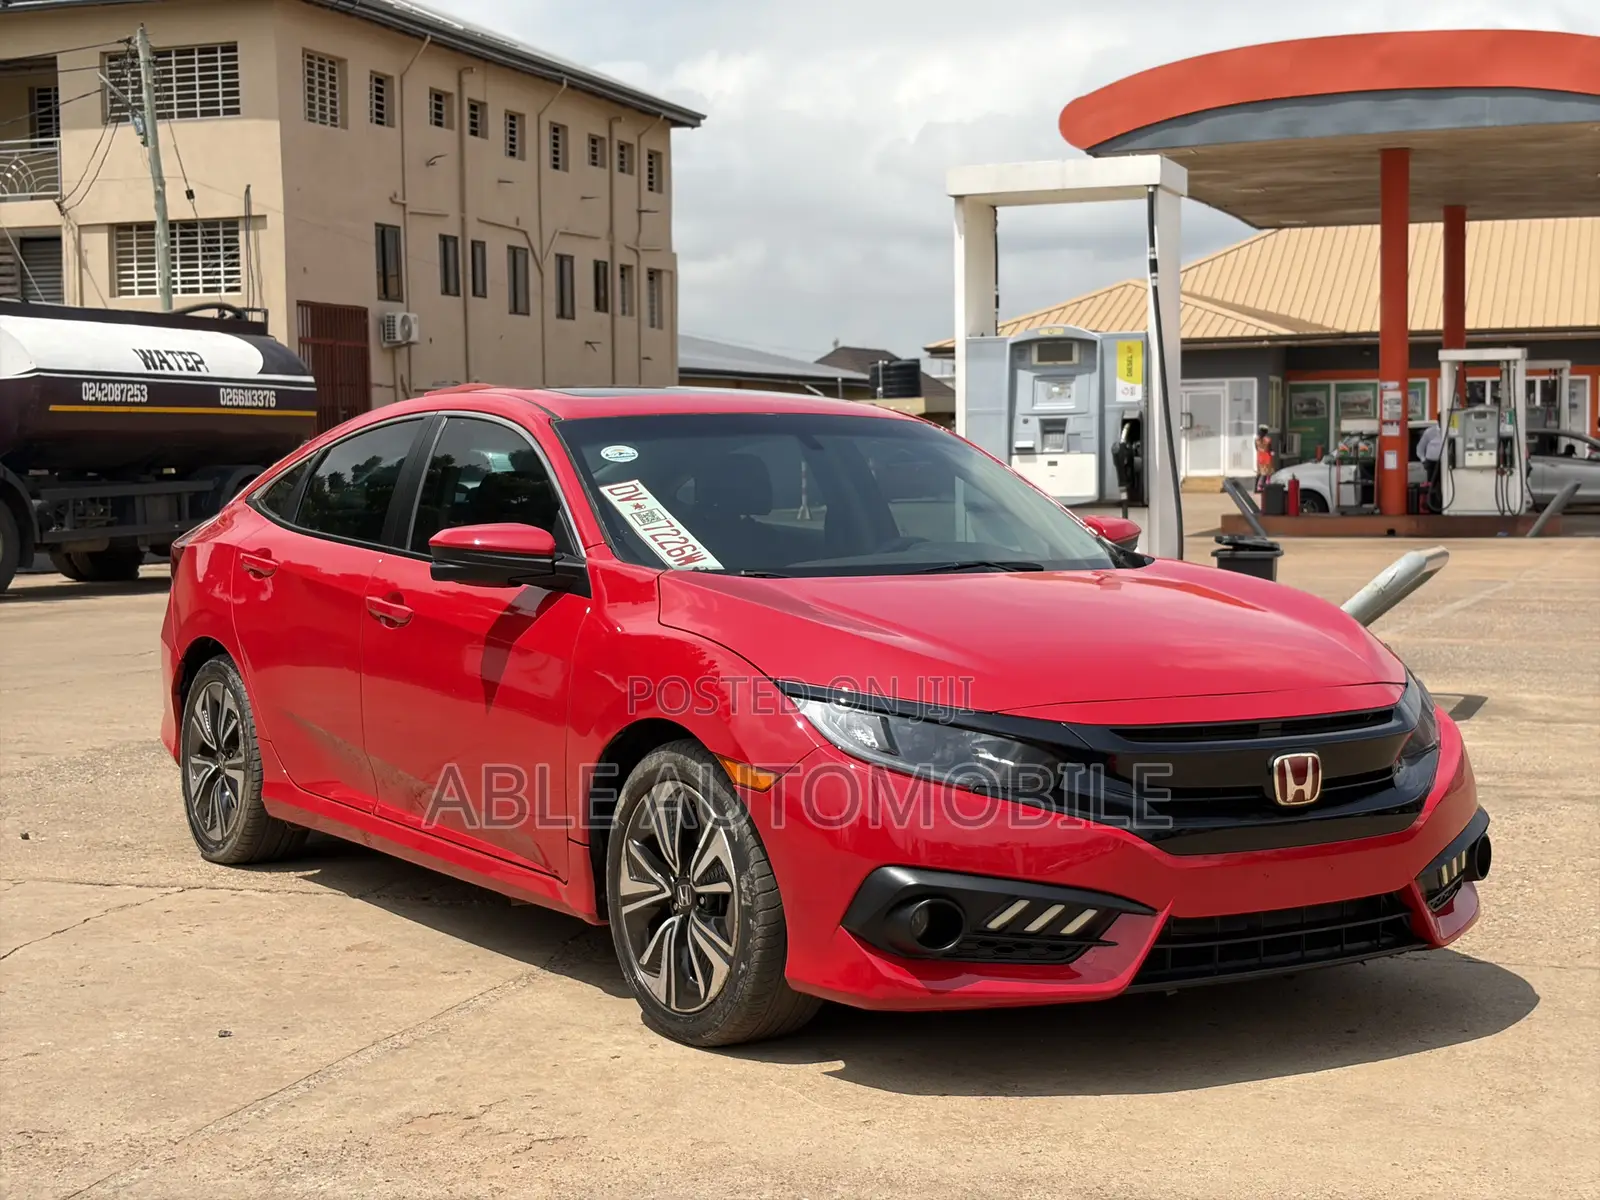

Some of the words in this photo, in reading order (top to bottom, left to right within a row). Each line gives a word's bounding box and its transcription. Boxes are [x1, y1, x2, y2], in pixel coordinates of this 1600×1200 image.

[131, 347, 210, 374] WATER
[82, 382, 148, 403] 0242087253
[220, 387, 277, 408] 0266113376
[607, 484, 648, 502] DV
